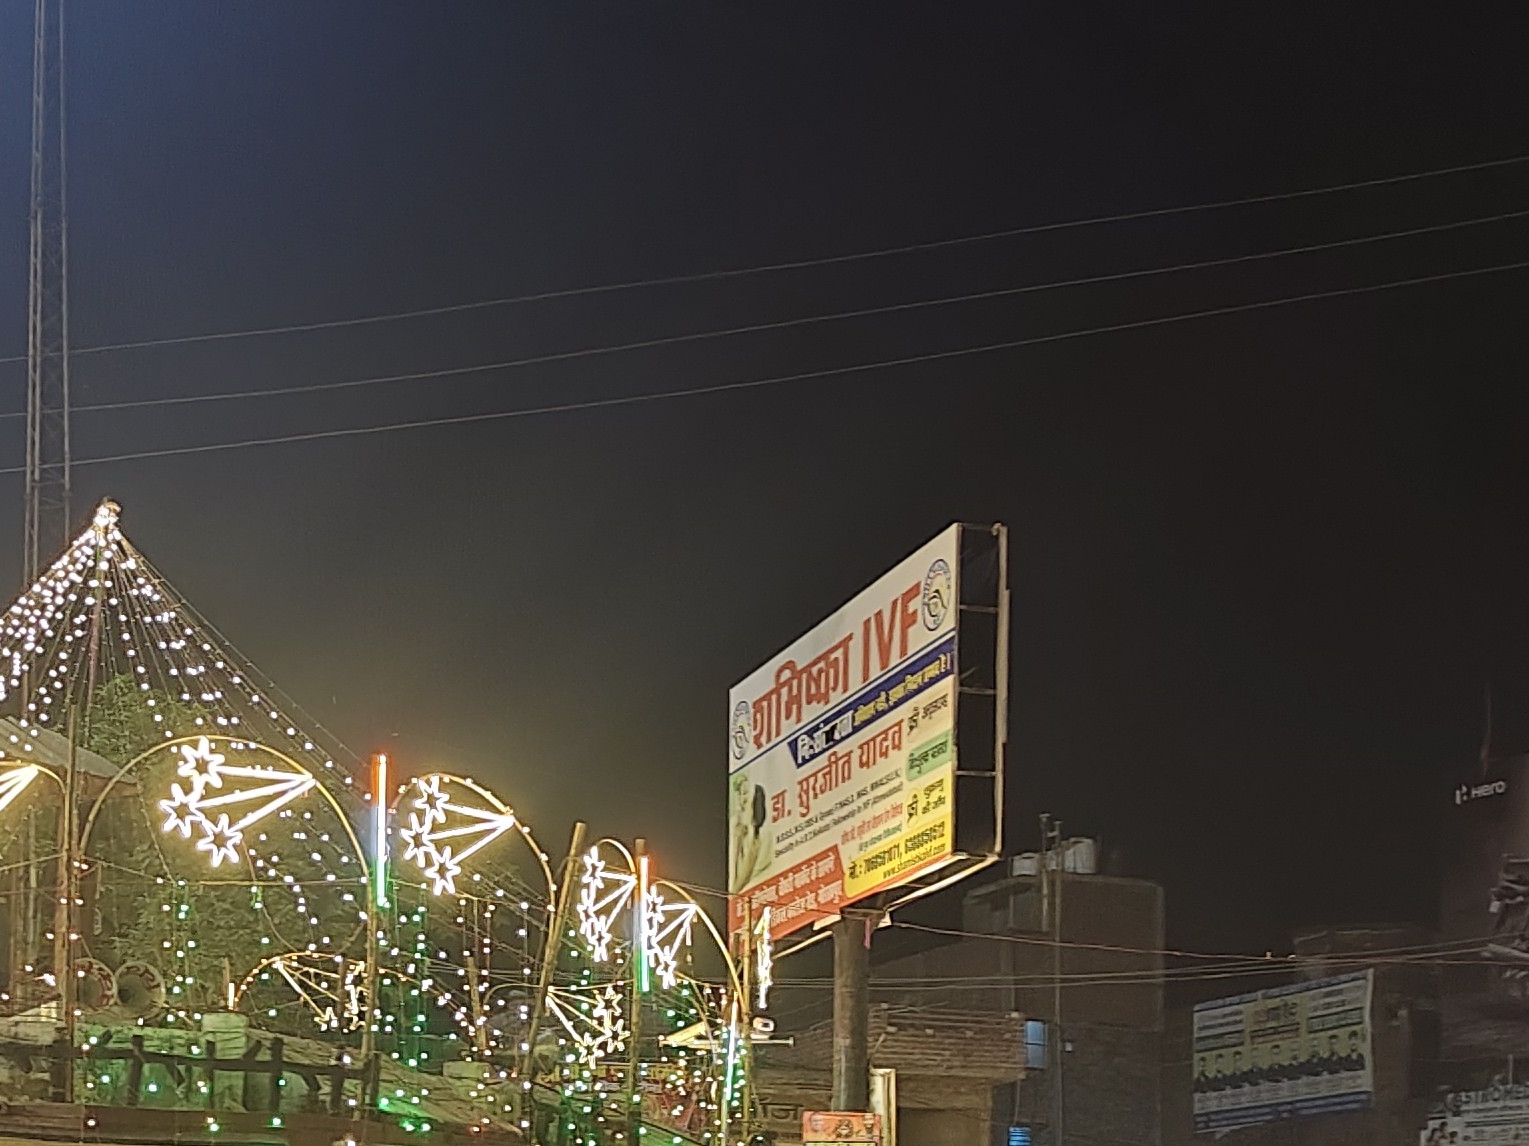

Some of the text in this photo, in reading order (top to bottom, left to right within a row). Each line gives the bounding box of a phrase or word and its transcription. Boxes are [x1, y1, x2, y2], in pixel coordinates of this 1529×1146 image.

[861, 581, 922, 683] IVF
[797, 751, 853, 818] सुरजीत
[858, 719, 904, 769] यादव
